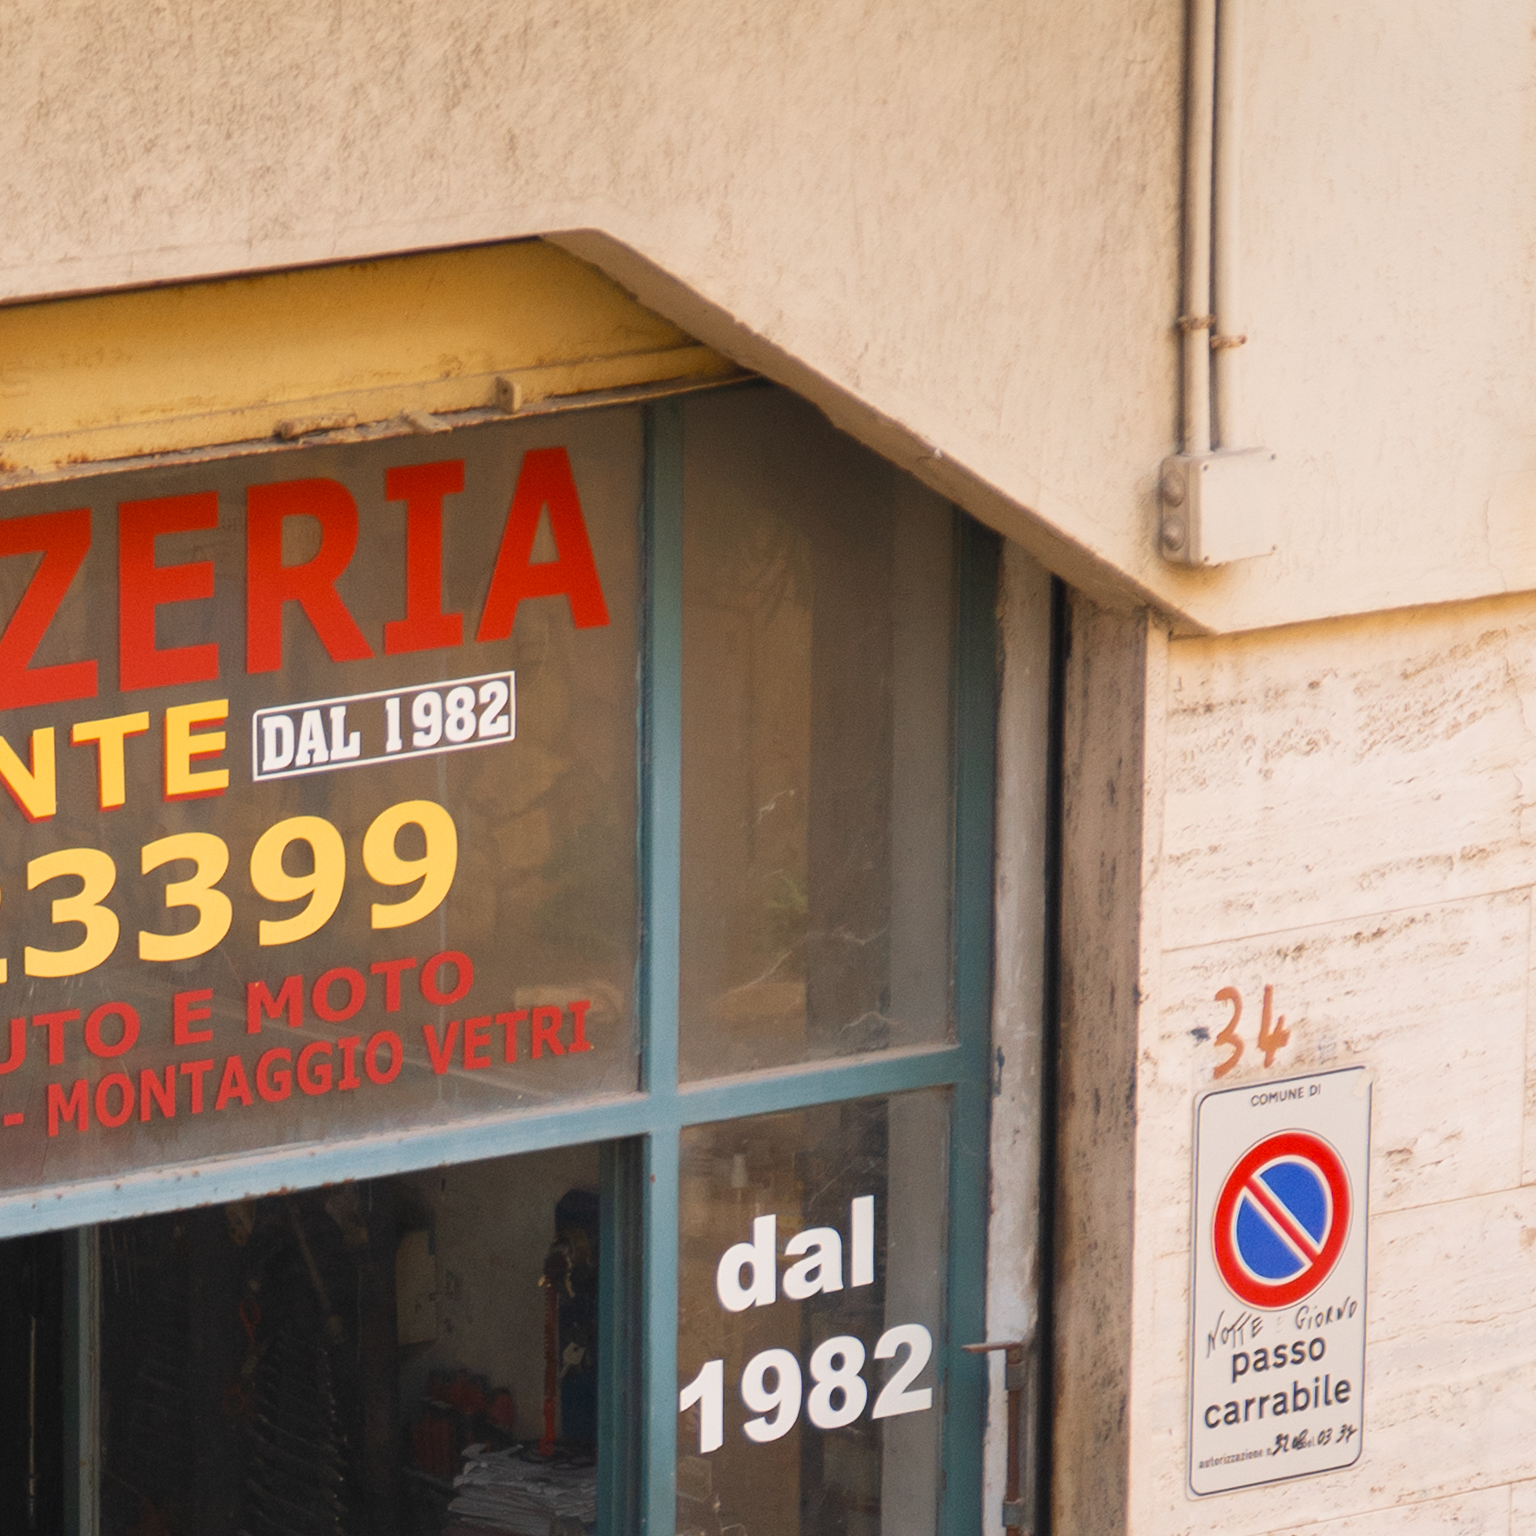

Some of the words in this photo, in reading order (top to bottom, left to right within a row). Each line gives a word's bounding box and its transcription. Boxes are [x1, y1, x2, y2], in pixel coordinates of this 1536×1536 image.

[262, 705, 361, 773] DAL
[384, 678, 510, 749] 1982
[173, 989, 214, 1046] E
[247, 951, 476, 1030] MOTO
[1213, 983, 1292, 1080] 34
[47, 1031, 405, 1138] MONTAGGIO
[428, 1001, 594, 1074] VETRI
[1250, 1086, 1305, 1107] COMUNE
[1309, 1084, 1322, 1097] DI
[715, 1195, 875, 1313] dal
[1207, 1309, 1264, 1359] NOTTE
[1231, 1336, 1326, 1384] passo
[678, 1323, 933, 1454] 1982
[1204, 1373, 1352, 1429] carrabile
